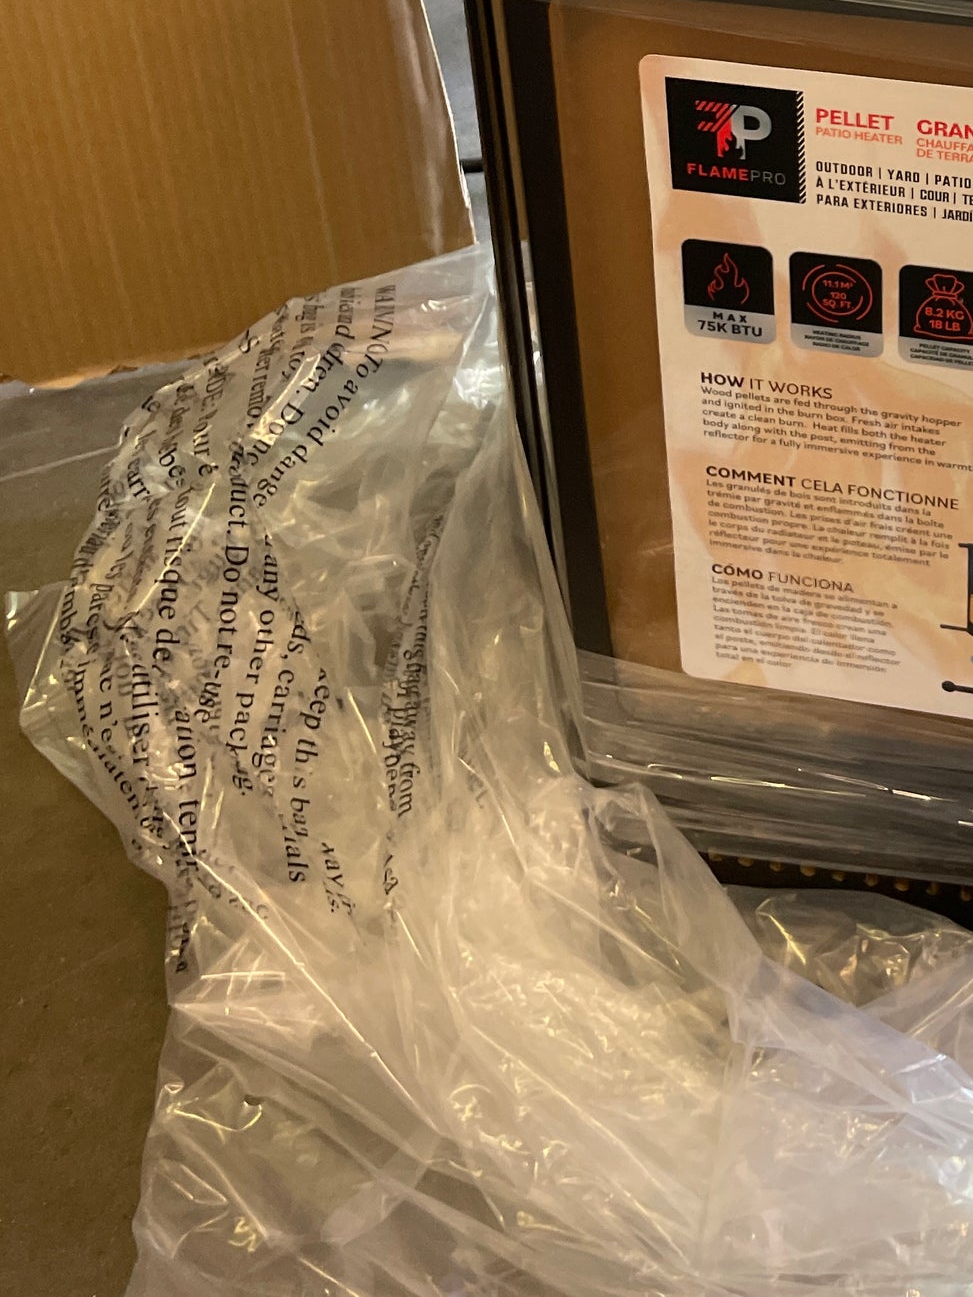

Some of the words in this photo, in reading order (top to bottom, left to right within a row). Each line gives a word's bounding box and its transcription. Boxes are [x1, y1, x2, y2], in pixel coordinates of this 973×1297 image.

[815, 107, 894, 130] PELLET
[815, 125, 851, 139] PATIO
[853, 130, 902, 144] HEATER
[915, 147, 933, 158] DE
[687, 162, 786, 185] FLAMEPRO
[815, 160, 872, 177] OUTDOOR
[887, 168, 919, 182] YARD
[934, 174, 971, 189] PATIO
[815, 175, 823, 188] À
[828, 178, 905, 197] L'EXTÉRIEUR
[920, 188, 949, 202] COUR
[816, 193, 848, 207] PARA
[853, 197, 927, 216] EXTERIORES
[821, 298, 836, 308] SQ.
[839, 300, 854, 311] FT.
[830, 291, 846, 299] 120
[712, 311, 747, 323] MAX
[924, 306, 943, 317] 8.2
[945, 309, 964, 320] KG
[929, 319, 942, 329] 18
[944, 320, 960, 331] LB
[697, 319, 727, 333] 75K
[731, 323, 762, 337] BTU
[356, 354, 383, 378] To
[700, 371, 744, 387] HOW
[749, 378, 762, 390] IT
[768, 380, 832, 399] WORKS
[269, 403, 305, 436] Do
[307, 380, 359, 445] avoid
[700, 384, 732, 397] Wood
[734, 391, 770, 402] pellets
[773, 397, 790, 405] are
[793, 397, 810, 407] fed
[813, 400, 857, 414] through
[859, 407, 878, 416] the
[880, 411, 918, 423] gravity
[921, 414, 961, 427] hopper
[701, 398, 721, 406] and
[723, 399, 761, 412] ignited
[764, 404, 774, 413] in
[776, 406, 794, 416] the
[796, 408, 823, 419] burn
[825, 412, 845, 422] box.
[851, 415, 881, 427] Fresh
[901, 422, 940, 435] intakes
[702, 408, 736, 419] create
[747, 413, 776, 424] clean
[778, 416, 806, 428] burn.
[812, 421, 837, 432] Heat
[840, 424, 858, 434] fills
[861, 427, 886, 438] both
[889, 432, 907, 441] the
[910, 434, 946, 446] heater
[702, 417, 729, 430] body
[731, 422, 761, 434] along
[763, 427, 787, 436] with
[789, 429, 807, 438] the
[810, 433, 837, 443] post,
[839, 437, 886, 450] emitting
[888, 441, 914, 452] from
[917, 446, 935, 455] the
[246, 439, 274, 467] no
[703, 429, 749, 441] reflector
[752, 434, 767, 443] for
[778, 437, 801, 450] fully
[803, 441, 859, 456] immersive
[861, 451, 921, 464] experience
[924, 457, 934, 466] in
[253, 444, 308, 507] dange
[705, 465, 795, 487] COMMENT
[800, 478, 842, 494] CELA
[847, 484, 958, 510] FONCTIONNE
[154, 536, 190, 620] risque
[223, 545, 250, 582] Do
[256, 554, 280, 602] any
[711, 563, 763, 580] CÓMO
[768, 571, 853, 592] FUNCIONA
[219, 591, 240, 635] not
[246, 610, 275, 684] other
[194, 643, 234, 724] re-use
